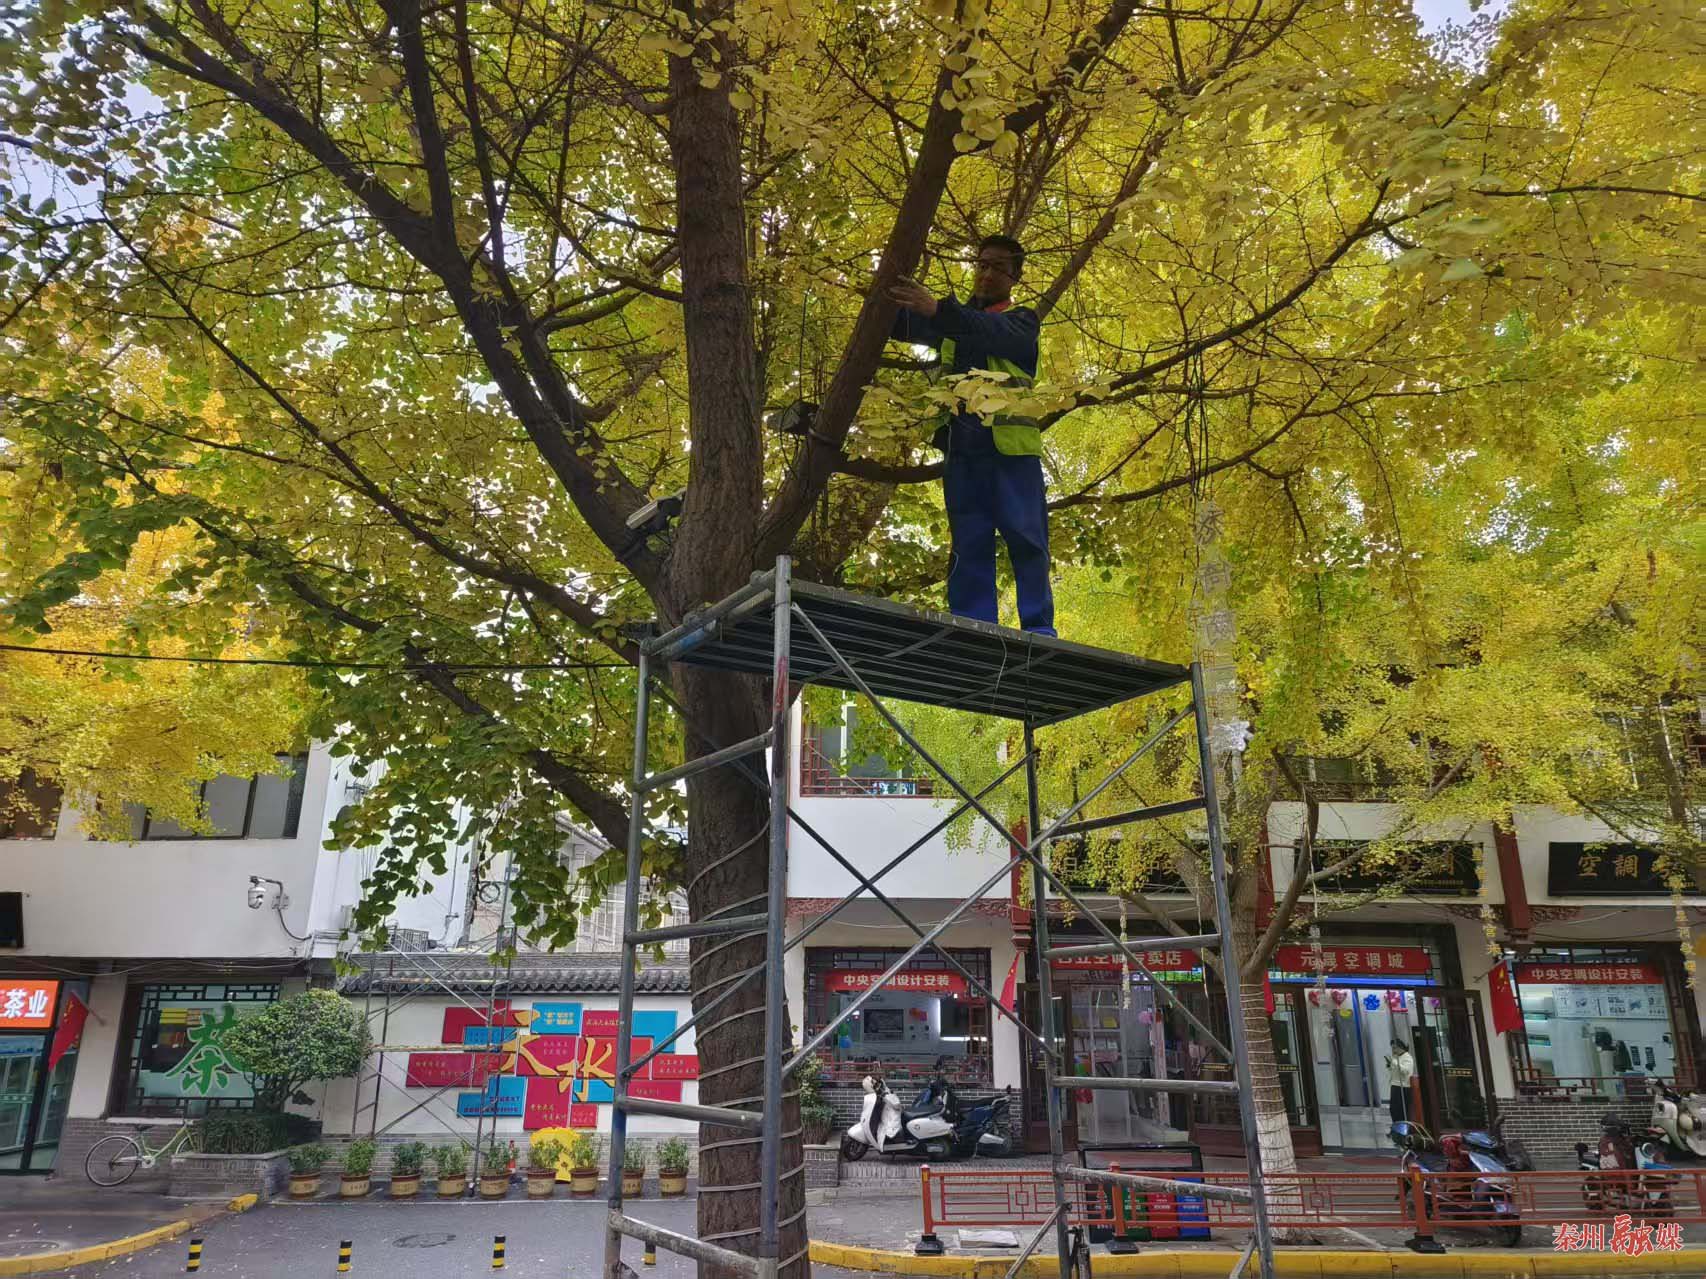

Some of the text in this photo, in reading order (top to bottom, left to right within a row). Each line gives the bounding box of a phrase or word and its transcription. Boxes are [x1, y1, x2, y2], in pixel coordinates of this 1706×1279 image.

[0, 988, 48, 1019] 茶业
[1532, 968, 1643, 980] 中央空调设计安装
[165, 1003, 244, 1097] 茶
[501, 1009, 616, 1102] 天水
